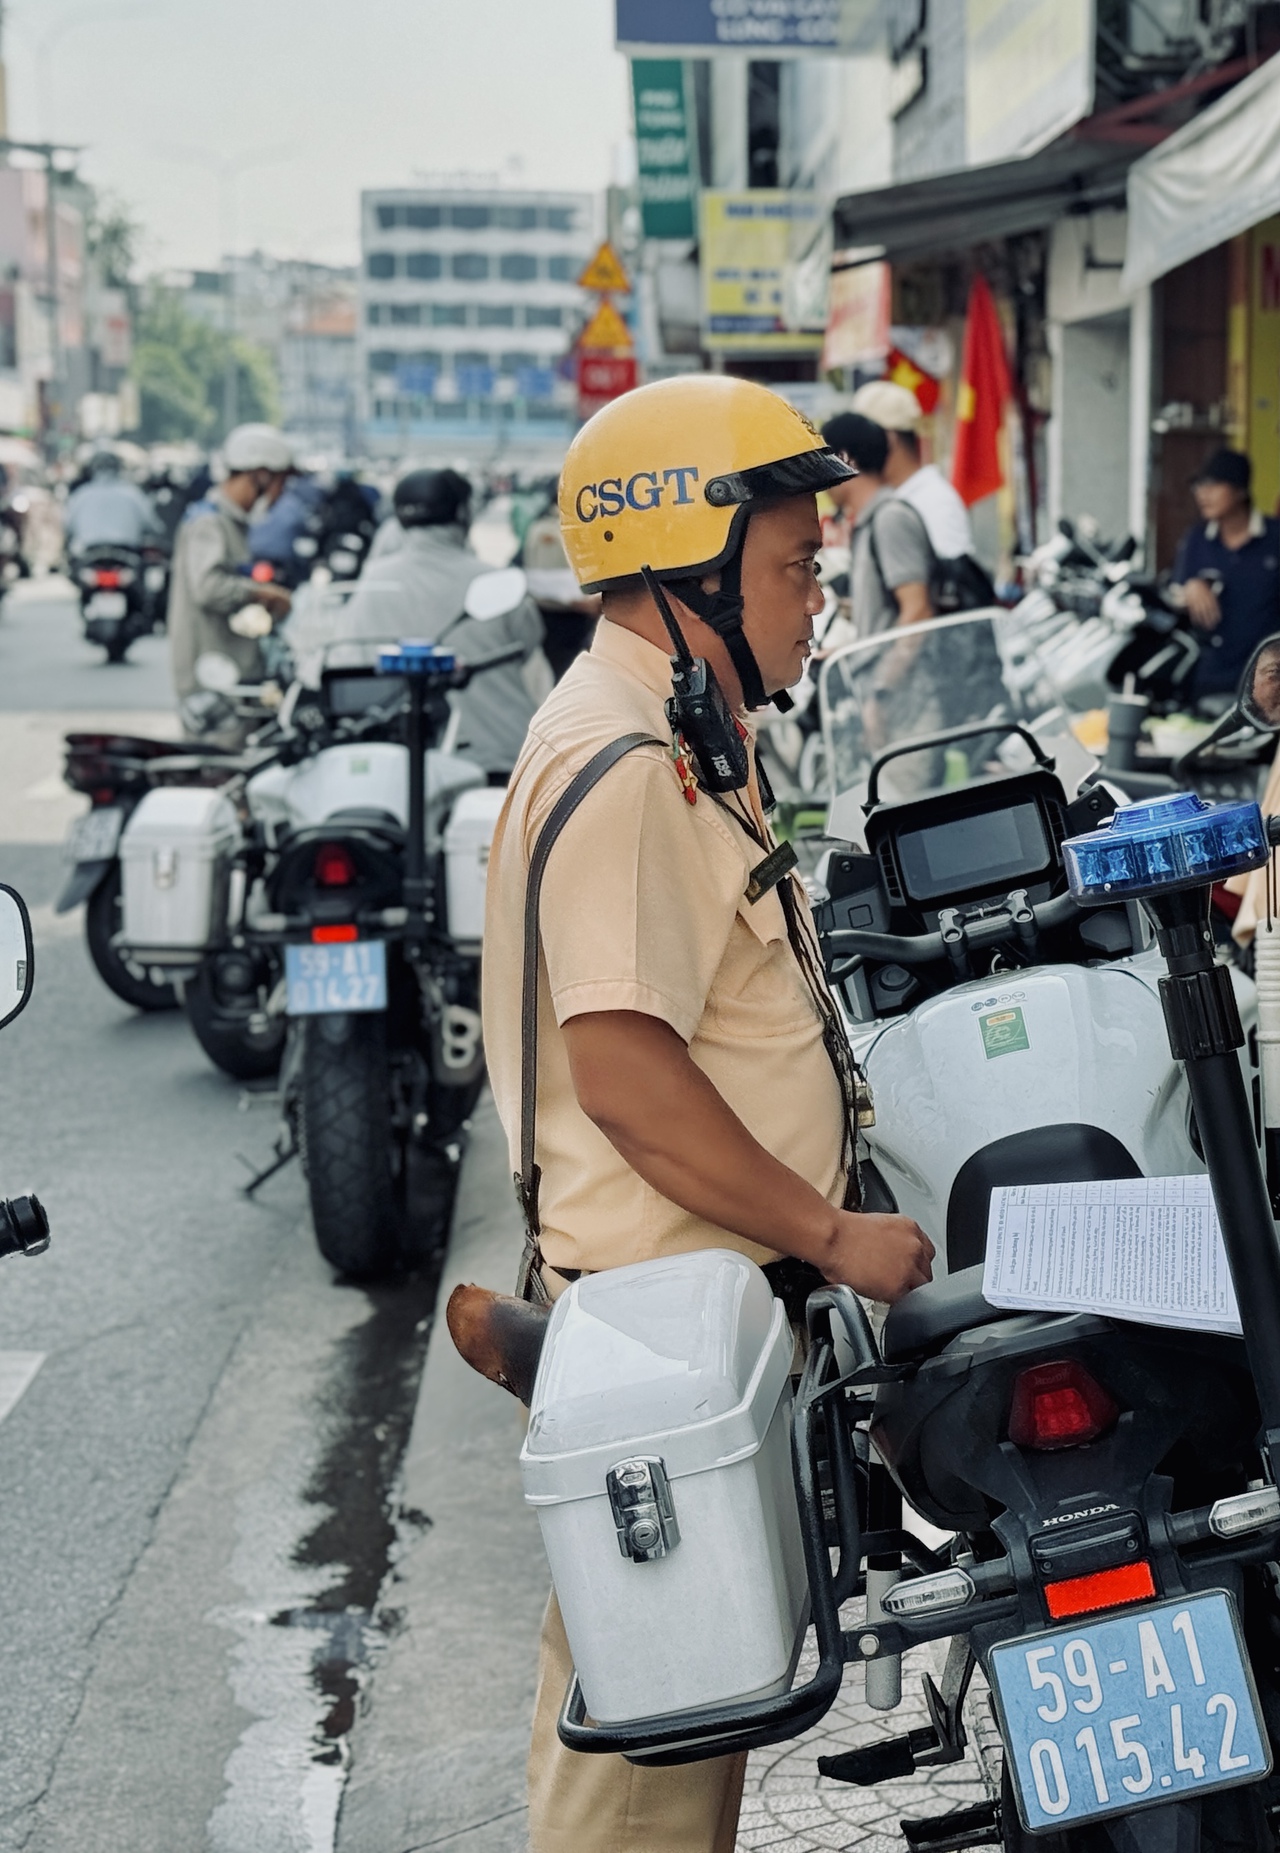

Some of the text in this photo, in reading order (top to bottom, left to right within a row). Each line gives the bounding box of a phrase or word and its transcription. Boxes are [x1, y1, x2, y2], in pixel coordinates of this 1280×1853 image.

[575, 466, 699, 523] CSGT
[1042, 1503, 1121, 1527] HONDA
[1025, 1610, 1206, 1724] 59-A1
[1028, 1692, 1251, 1816] 015.42
